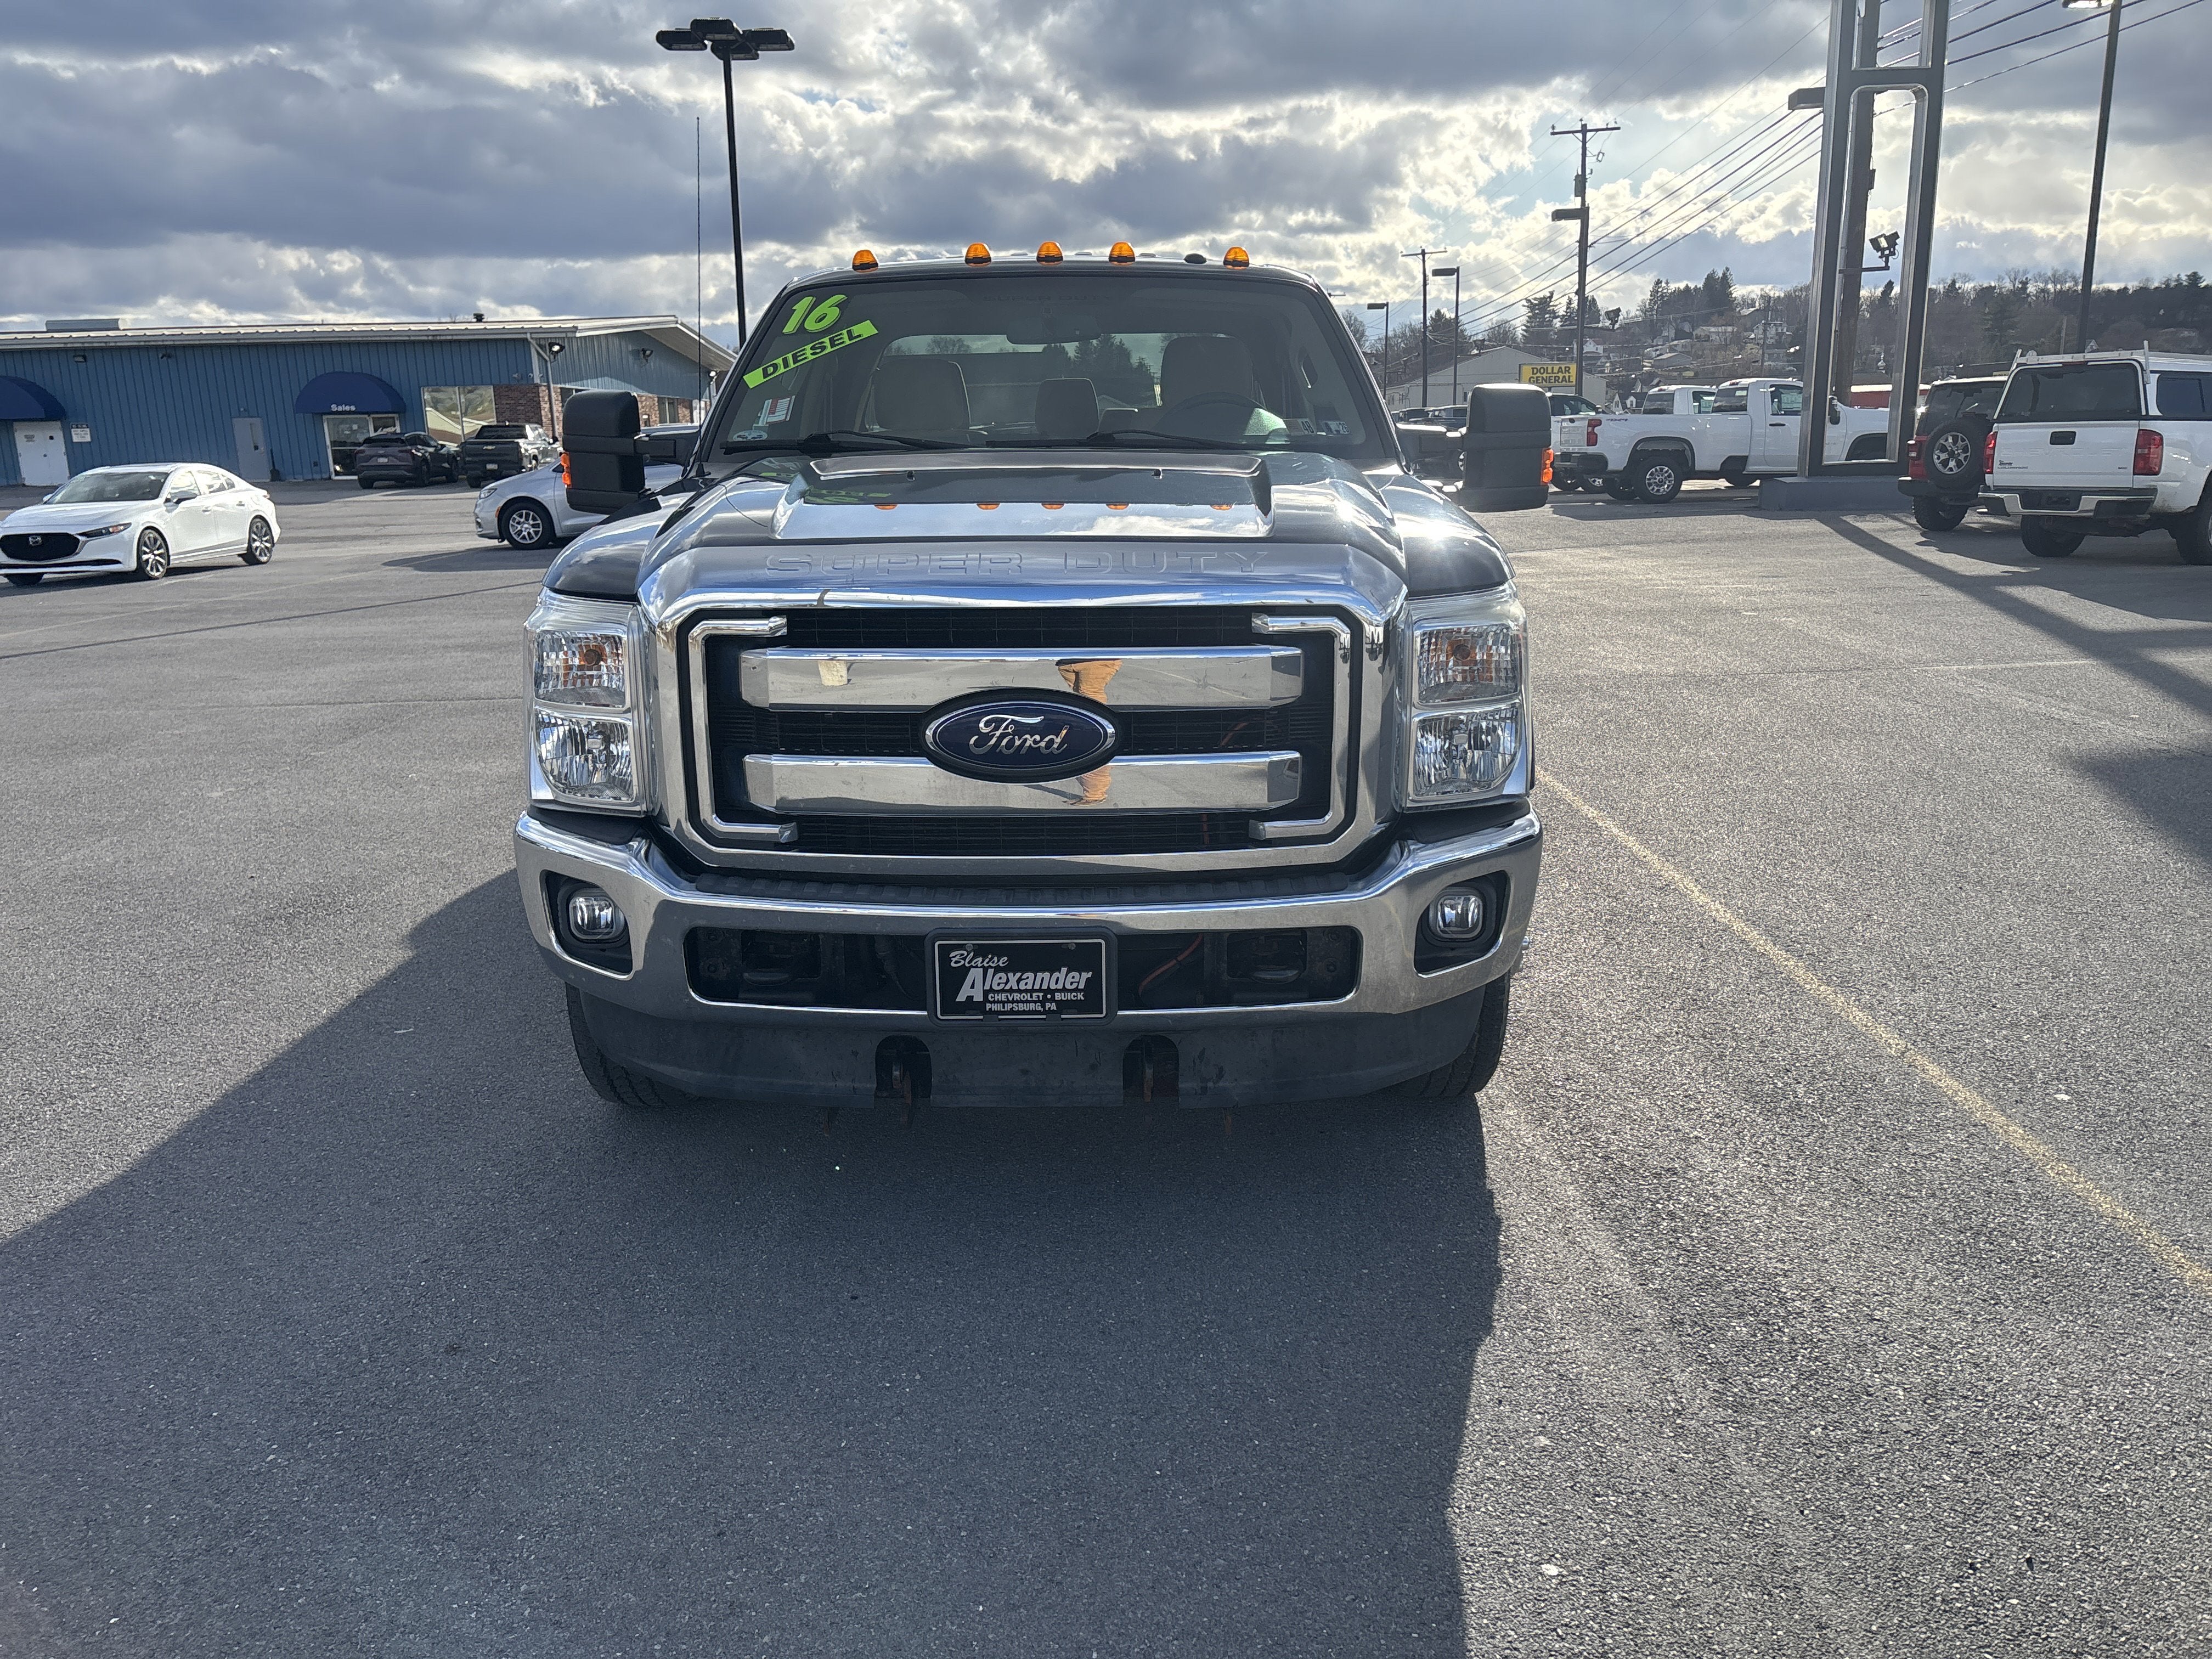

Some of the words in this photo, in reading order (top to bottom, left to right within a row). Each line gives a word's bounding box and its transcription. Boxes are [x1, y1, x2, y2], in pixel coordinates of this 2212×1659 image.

[782, 294, 847, 334] 16
[761, 328, 864, 380] DIESEL
[1528, 375, 1573, 383] GENERAL
[1531, 366, 1571, 375] DOLLAR
[765, 552, 1023, 576] SUPER
[1064, 551, 1269, 574] DUTY
[968, 714, 1070, 755] Ford
[949, 950, 1009, 967] Blaise
[955, 967, 1092, 1002] Alexander
[986, 1002, 1043, 1012] PHILIPSBURG,
[1046, 1002, 1057, 1011] PA
[988, 992, 1044, 1001] CHEVROLET
[1054, 992, 1085, 1001] BUICK
